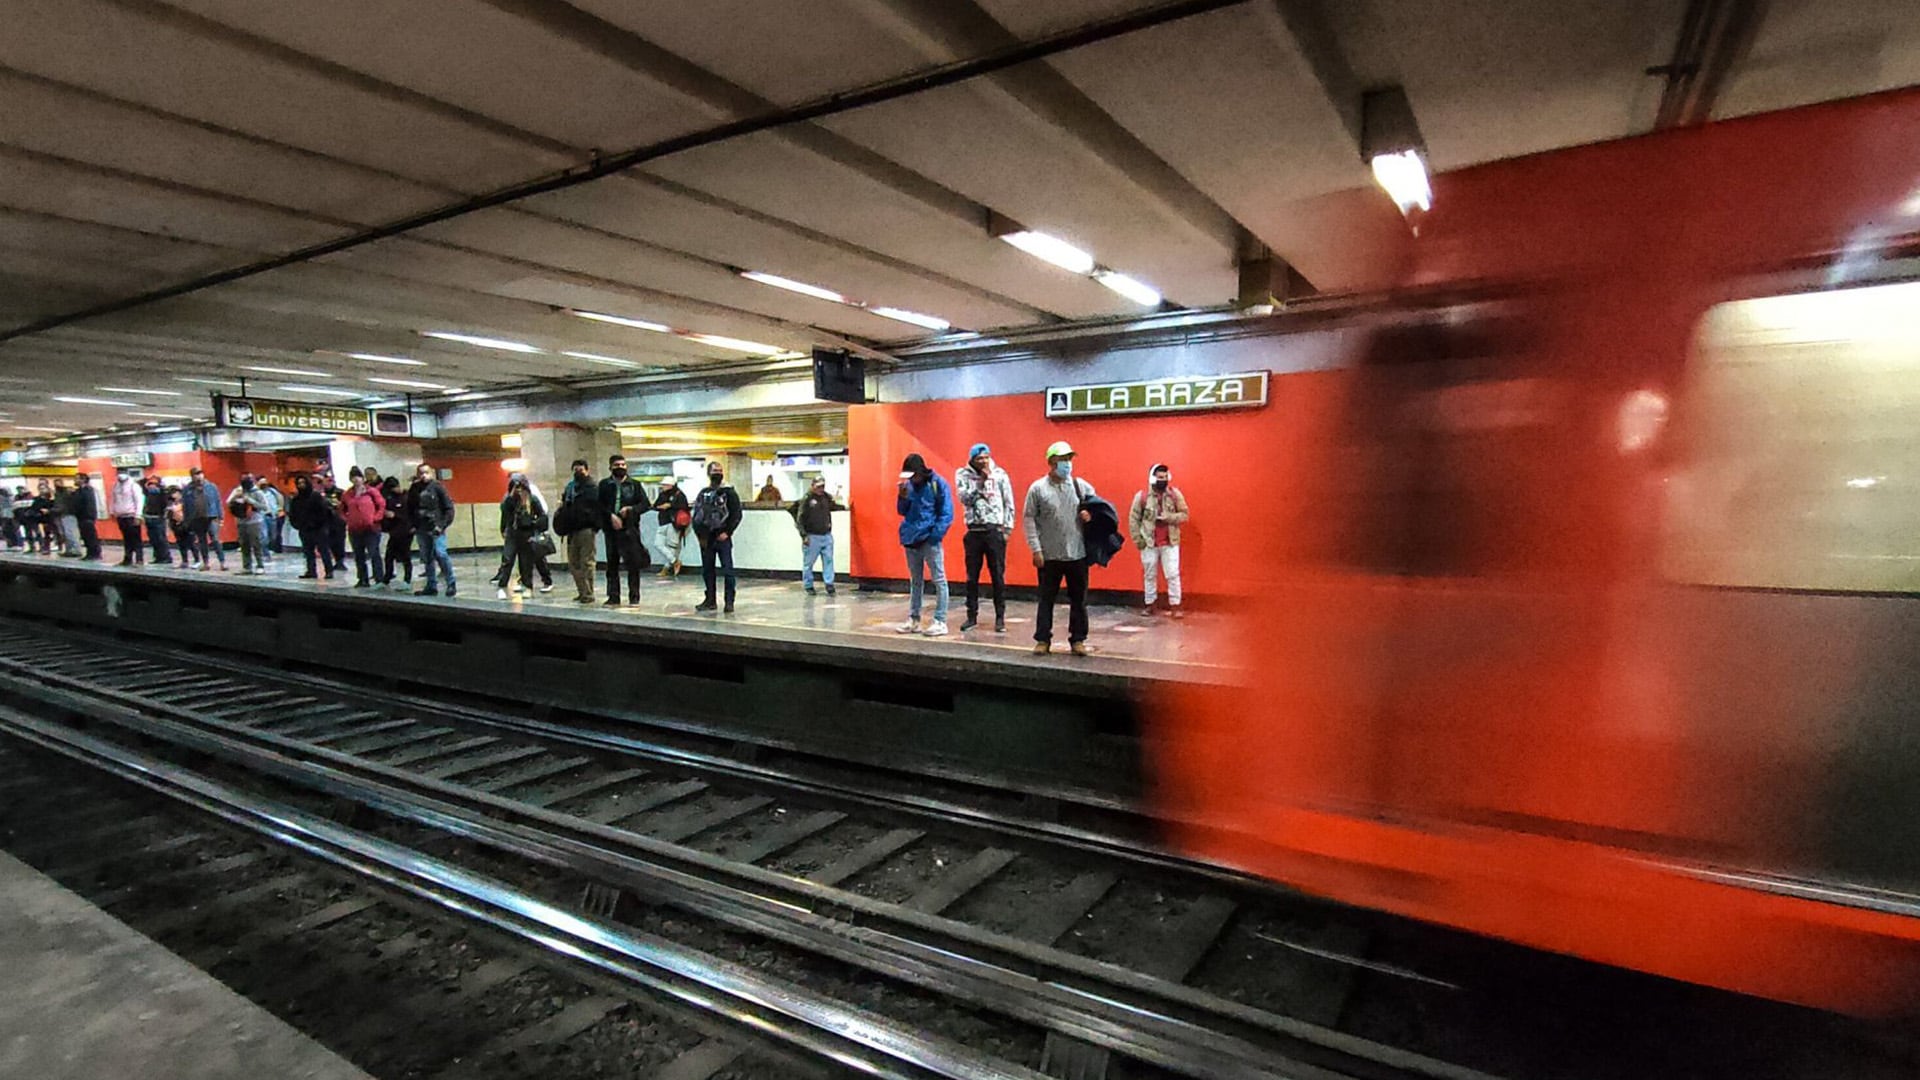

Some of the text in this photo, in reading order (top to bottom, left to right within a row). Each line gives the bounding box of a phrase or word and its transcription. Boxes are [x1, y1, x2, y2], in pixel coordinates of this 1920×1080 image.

[1086, 379, 1244, 410] LA RAZA
[256, 413, 368, 431] UNIVERSIDAD
